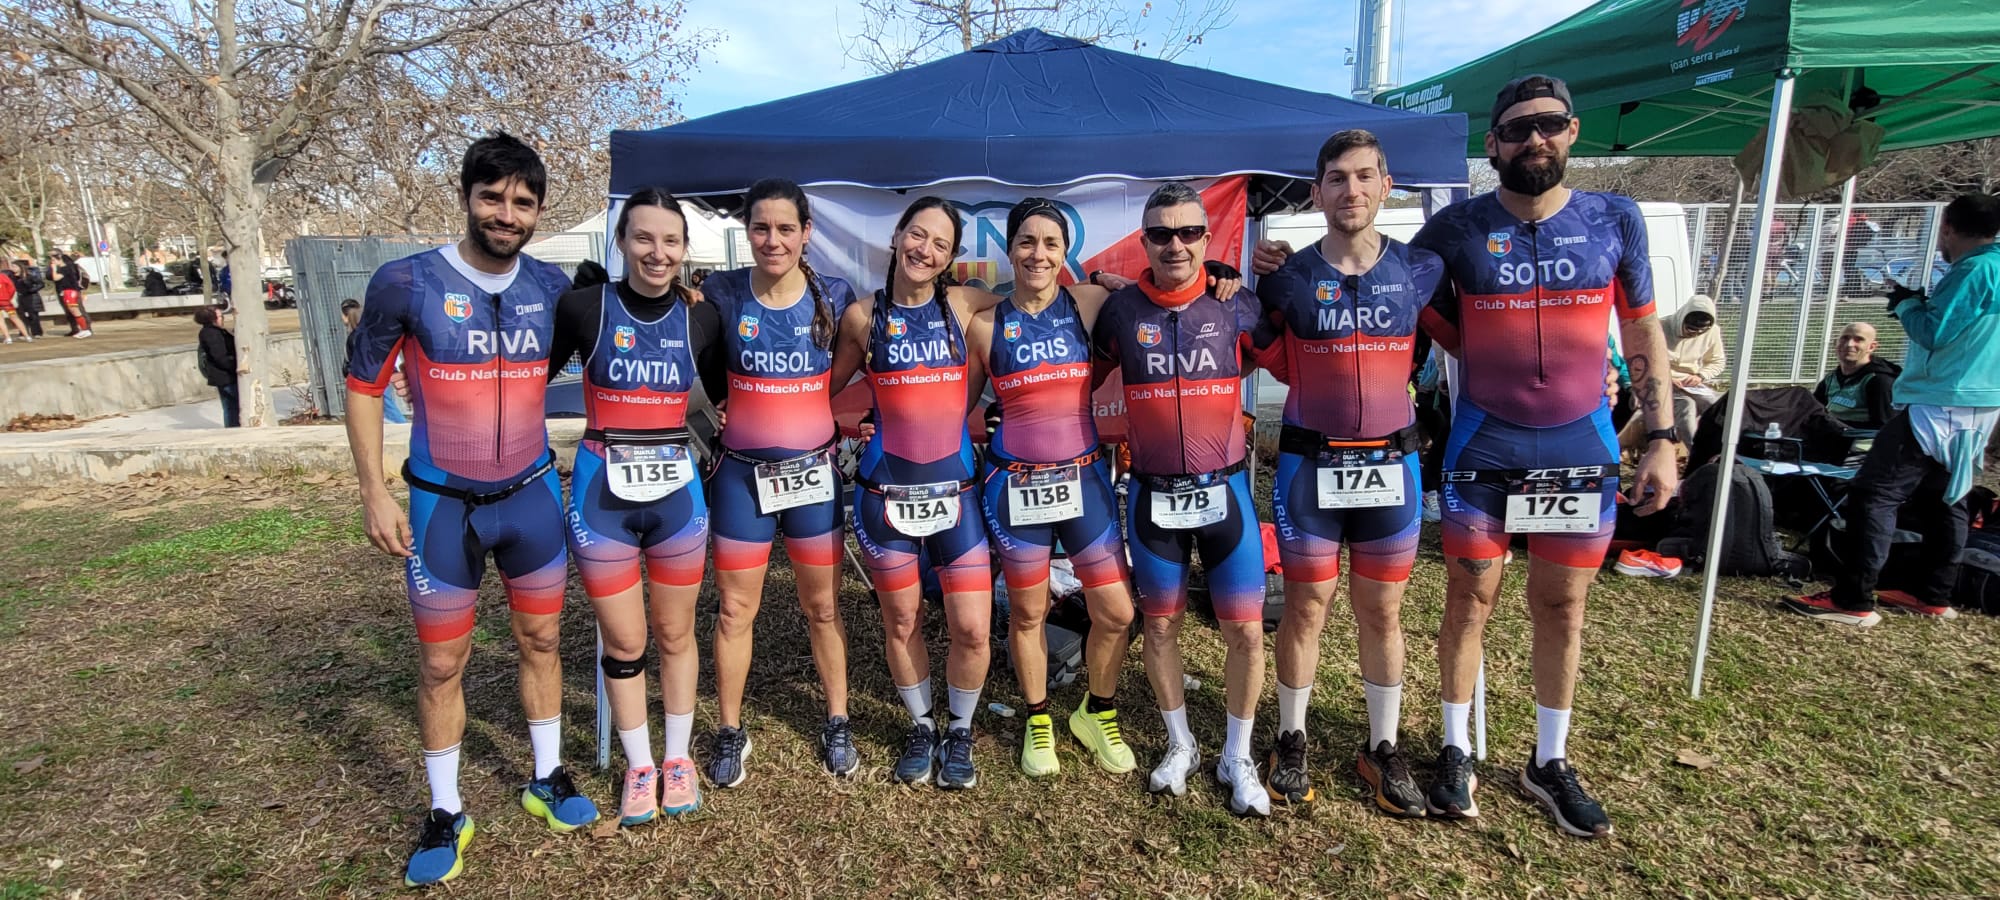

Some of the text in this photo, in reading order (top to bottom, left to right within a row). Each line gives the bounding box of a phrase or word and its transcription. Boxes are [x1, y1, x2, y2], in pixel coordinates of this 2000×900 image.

[1670, 59, 1689, 73] joan
[1691, 52, 1713, 65] serra
[1405, 91, 1420, 108] CLUB
[1499, 258, 1576, 285] SOTO
[1475, 293, 1604, 310] Club Natació Rubí
[1318, 305, 1391, 331] MARC
[467, 329, 540, 355] RIVA
[888, 339, 951, 364] SÖLVIA
[1016, 337, 1068, 364] CRIS
[1303, 341, 1410, 353] Club Natació Rubí
[609, 358, 680, 384] CYNTIA
[741, 350, 814, 373] CRISOL
[1147, 348, 1217, 375] RIVA
[429, 368, 466, 380] Club
[470, 368, 530, 380] Natació
[878, 371, 962, 386] Club Natació Rubí
[998, 379, 1021, 391] Club
[1023, 370, 1068, 385] Natació
[732, 379, 823, 393] Club Natació Rubí
[1130, 383, 1234, 400] Club Natació Rubí
[597, 392, 619, 401] Club
[622, 395, 662, 404] Natació
[1092, 400, 1127, 417] iatl
[621, 463, 679, 484] 113E
[769, 469, 821, 494] 113C
[1333, 468, 1386, 490] 17A
[1020, 484, 1070, 507] 113B
[1165, 490, 1209, 512] 17B
[1444, 483, 1465, 512] Rubí
[1525, 496, 1580, 515] 17C
[895, 500, 948, 520] 113A
[569, 510, 594, 548] Rubí
[989, 518, 1017, 550] Rubí
[1275, 505, 1300, 541] Rubí
[857, 528, 885, 559] Rubí
[408, 554, 437, 596] Rubí
